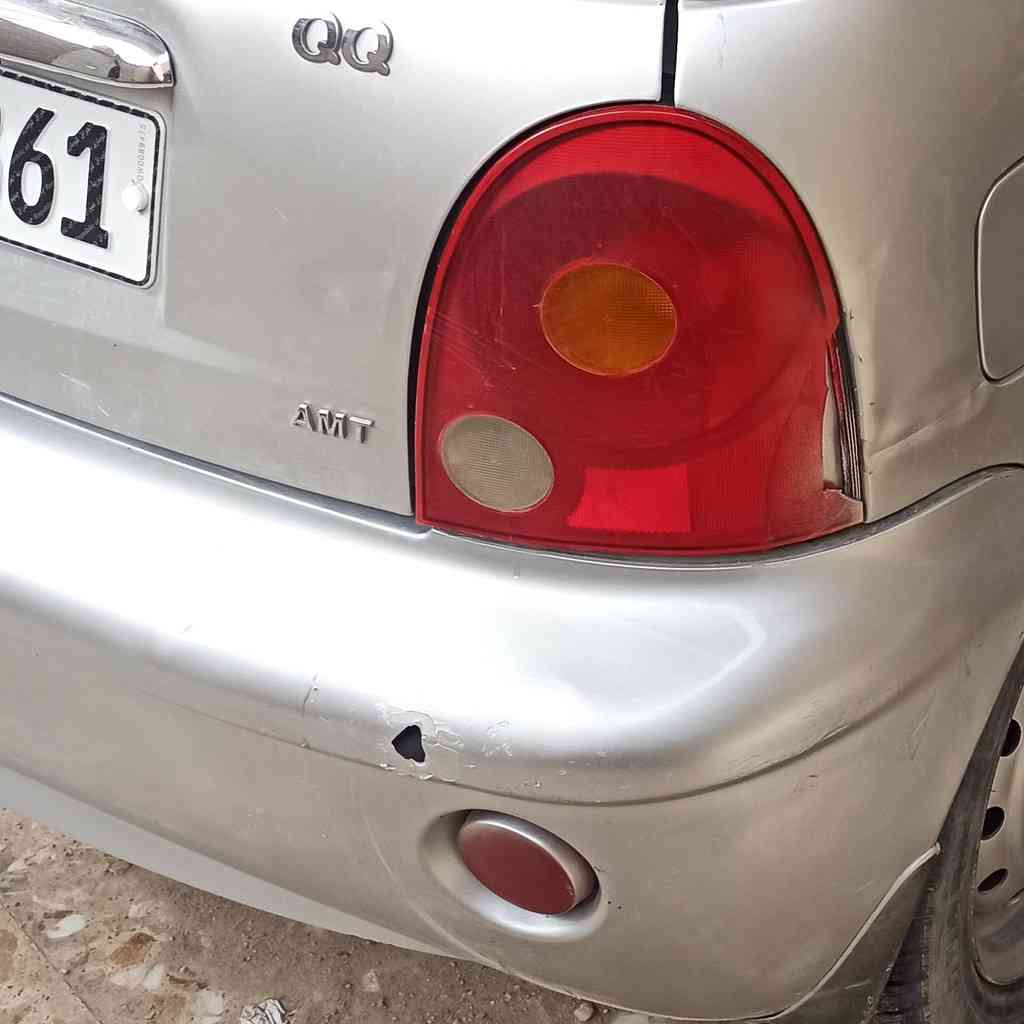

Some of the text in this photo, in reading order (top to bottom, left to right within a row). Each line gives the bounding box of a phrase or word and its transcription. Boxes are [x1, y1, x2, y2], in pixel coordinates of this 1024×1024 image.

[292, 12, 393, 76] QQ
[0, 107, 109, 249] 61
[292, 402, 375, 444] AMT
